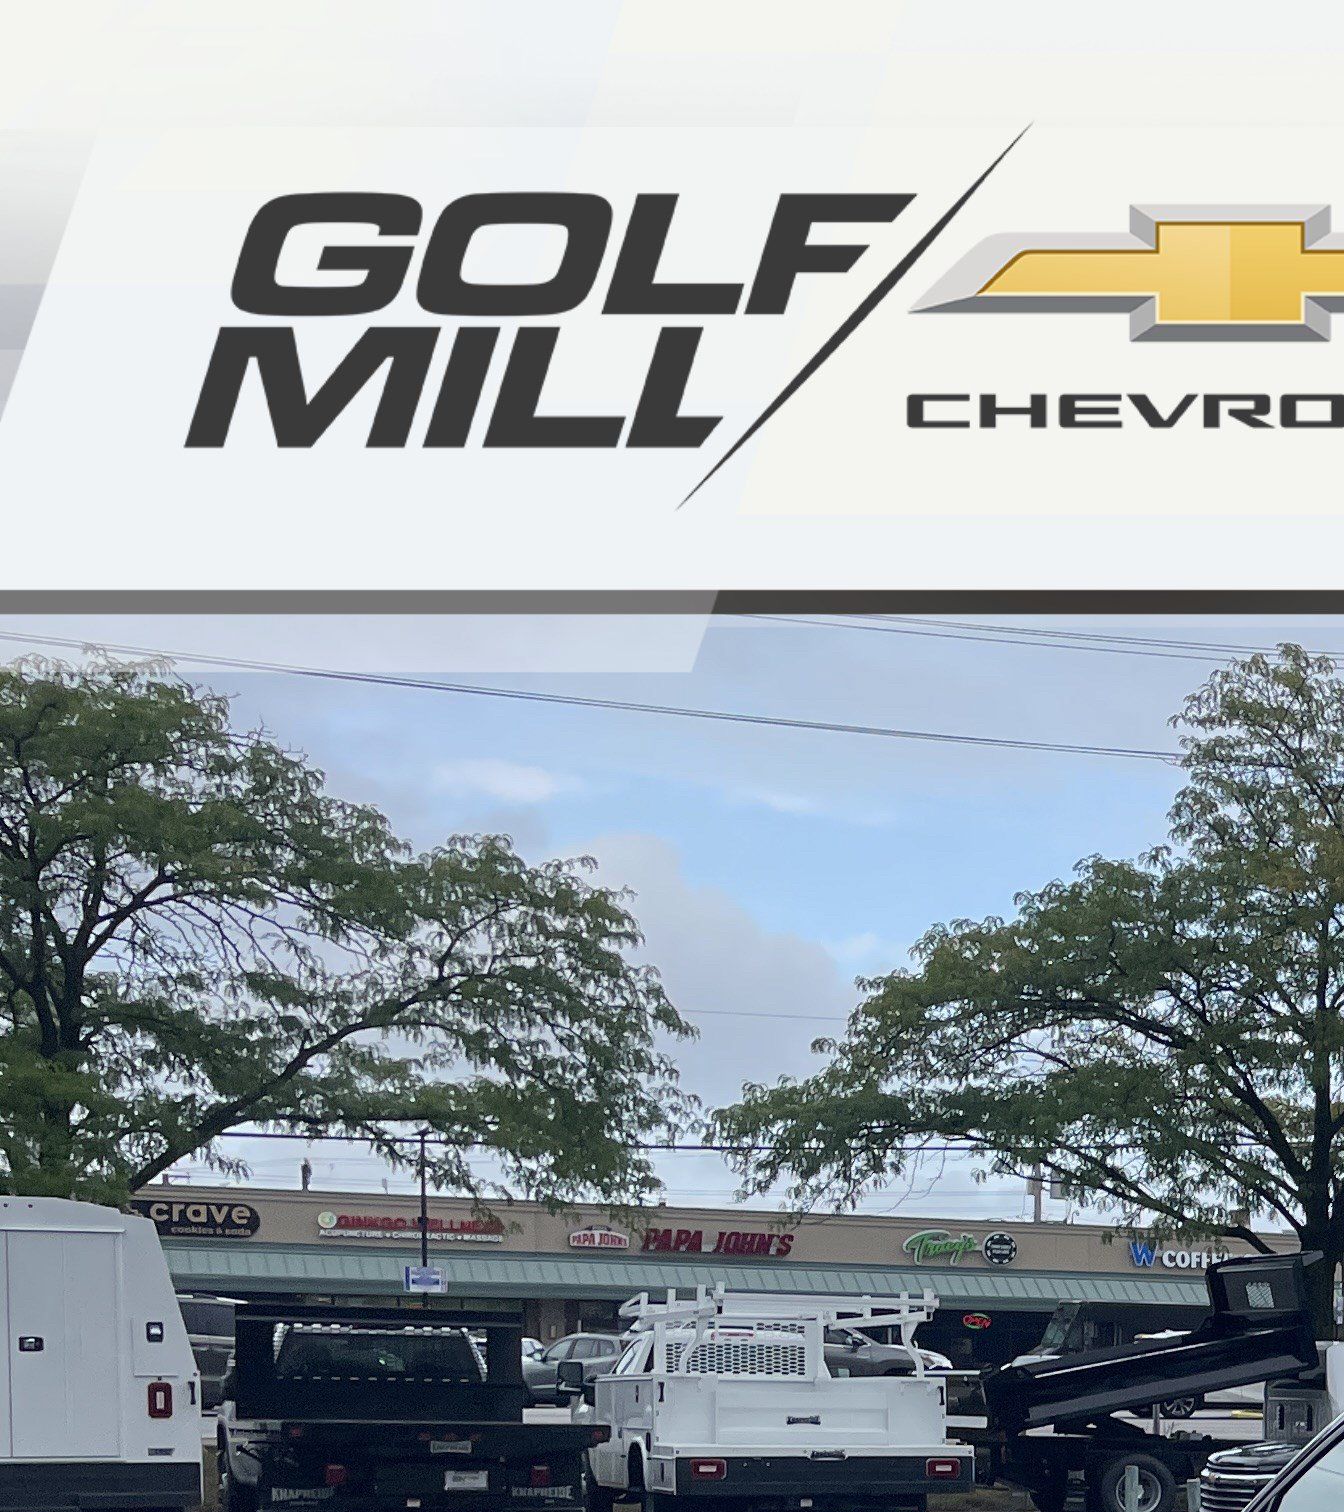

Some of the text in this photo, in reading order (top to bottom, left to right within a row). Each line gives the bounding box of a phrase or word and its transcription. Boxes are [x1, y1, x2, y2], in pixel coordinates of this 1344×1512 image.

[149, 1202, 251, 1224] crave
[643, 1228, 794, 1257] PAPA JOHN'S
